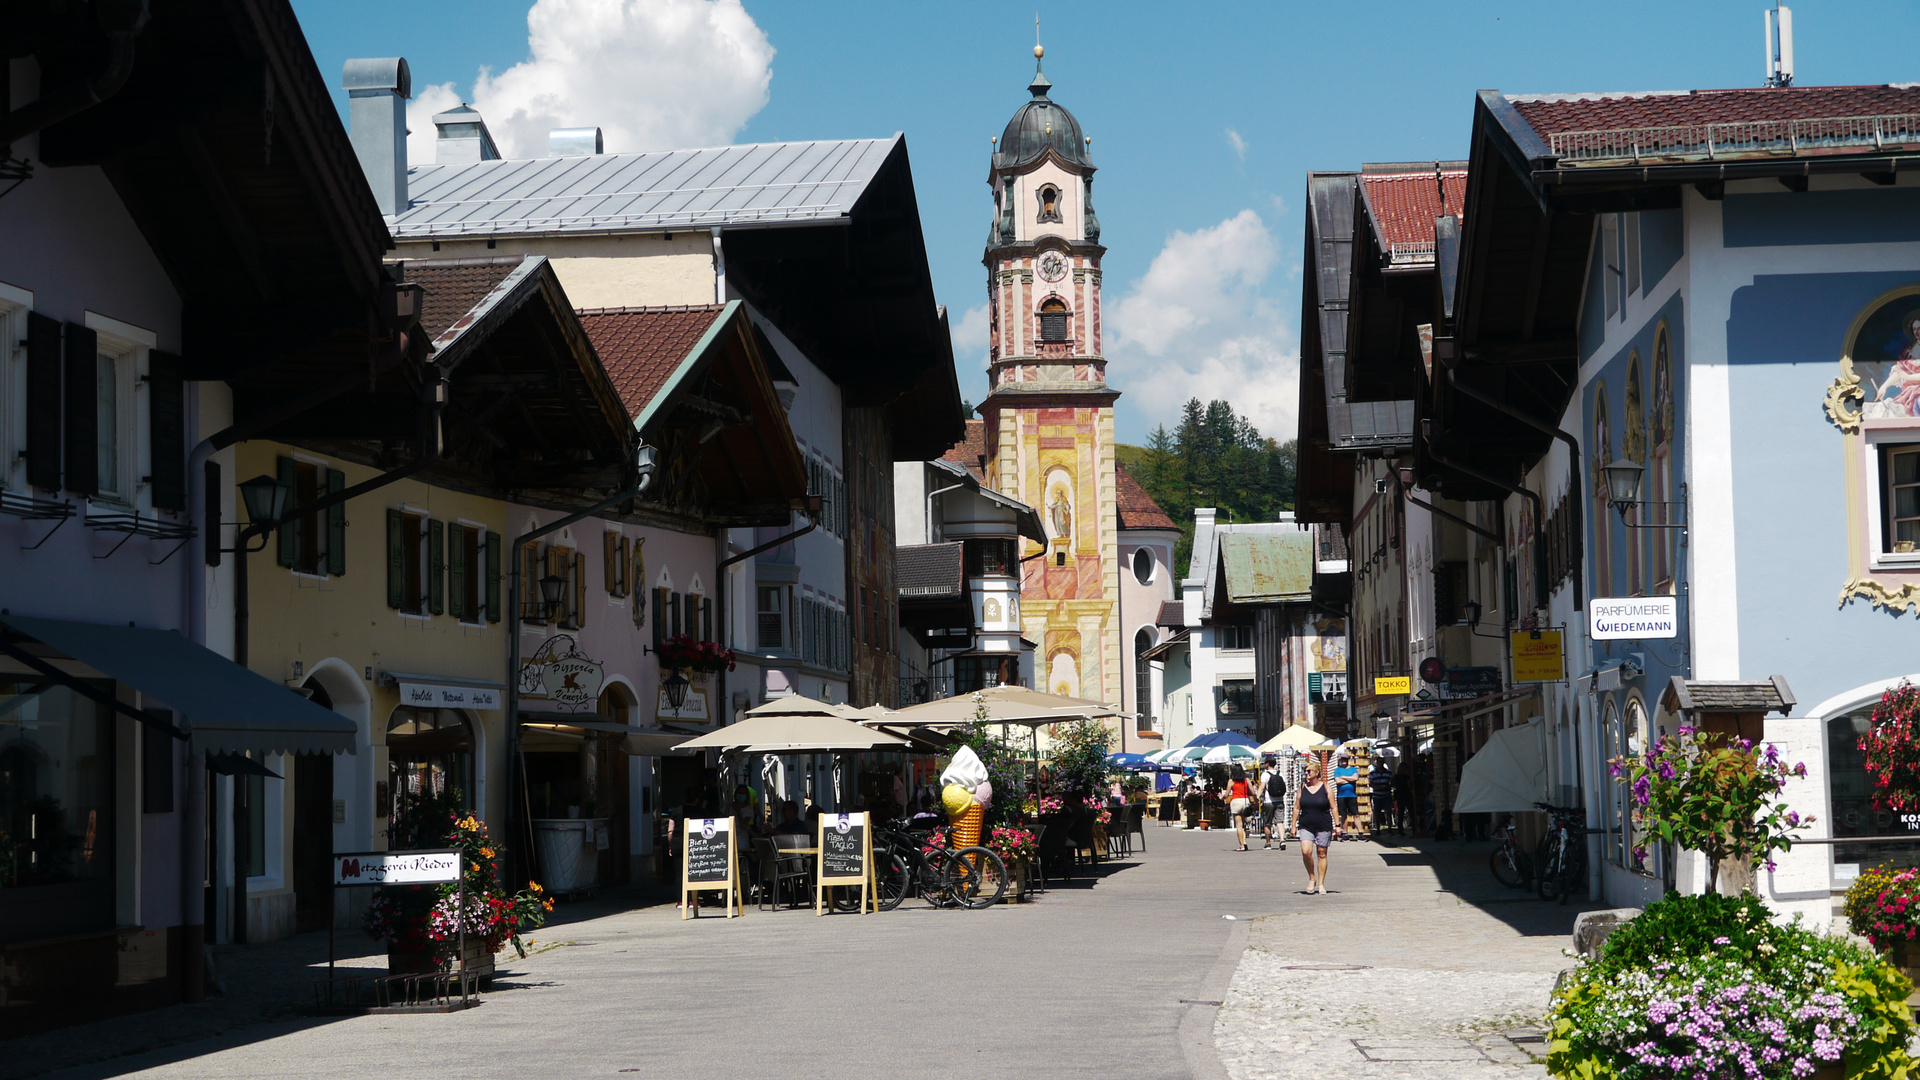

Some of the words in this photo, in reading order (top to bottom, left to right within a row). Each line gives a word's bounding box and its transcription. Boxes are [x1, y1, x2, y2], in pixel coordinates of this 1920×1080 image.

[1596, 604, 1670, 616] PARFÜMERIE
[1596, 619, 1671, 632] WIEDEMANN
[552, 663, 594, 675] Pizzeria
[1451, 683, 1468, 691] Alpen
[1469, 682, 1496, 691] Apotheke
[555, 689, 589, 703] Venezia
[341, 858, 407, 881] Metzgerei
[410, 857, 453, 872] Rieder
